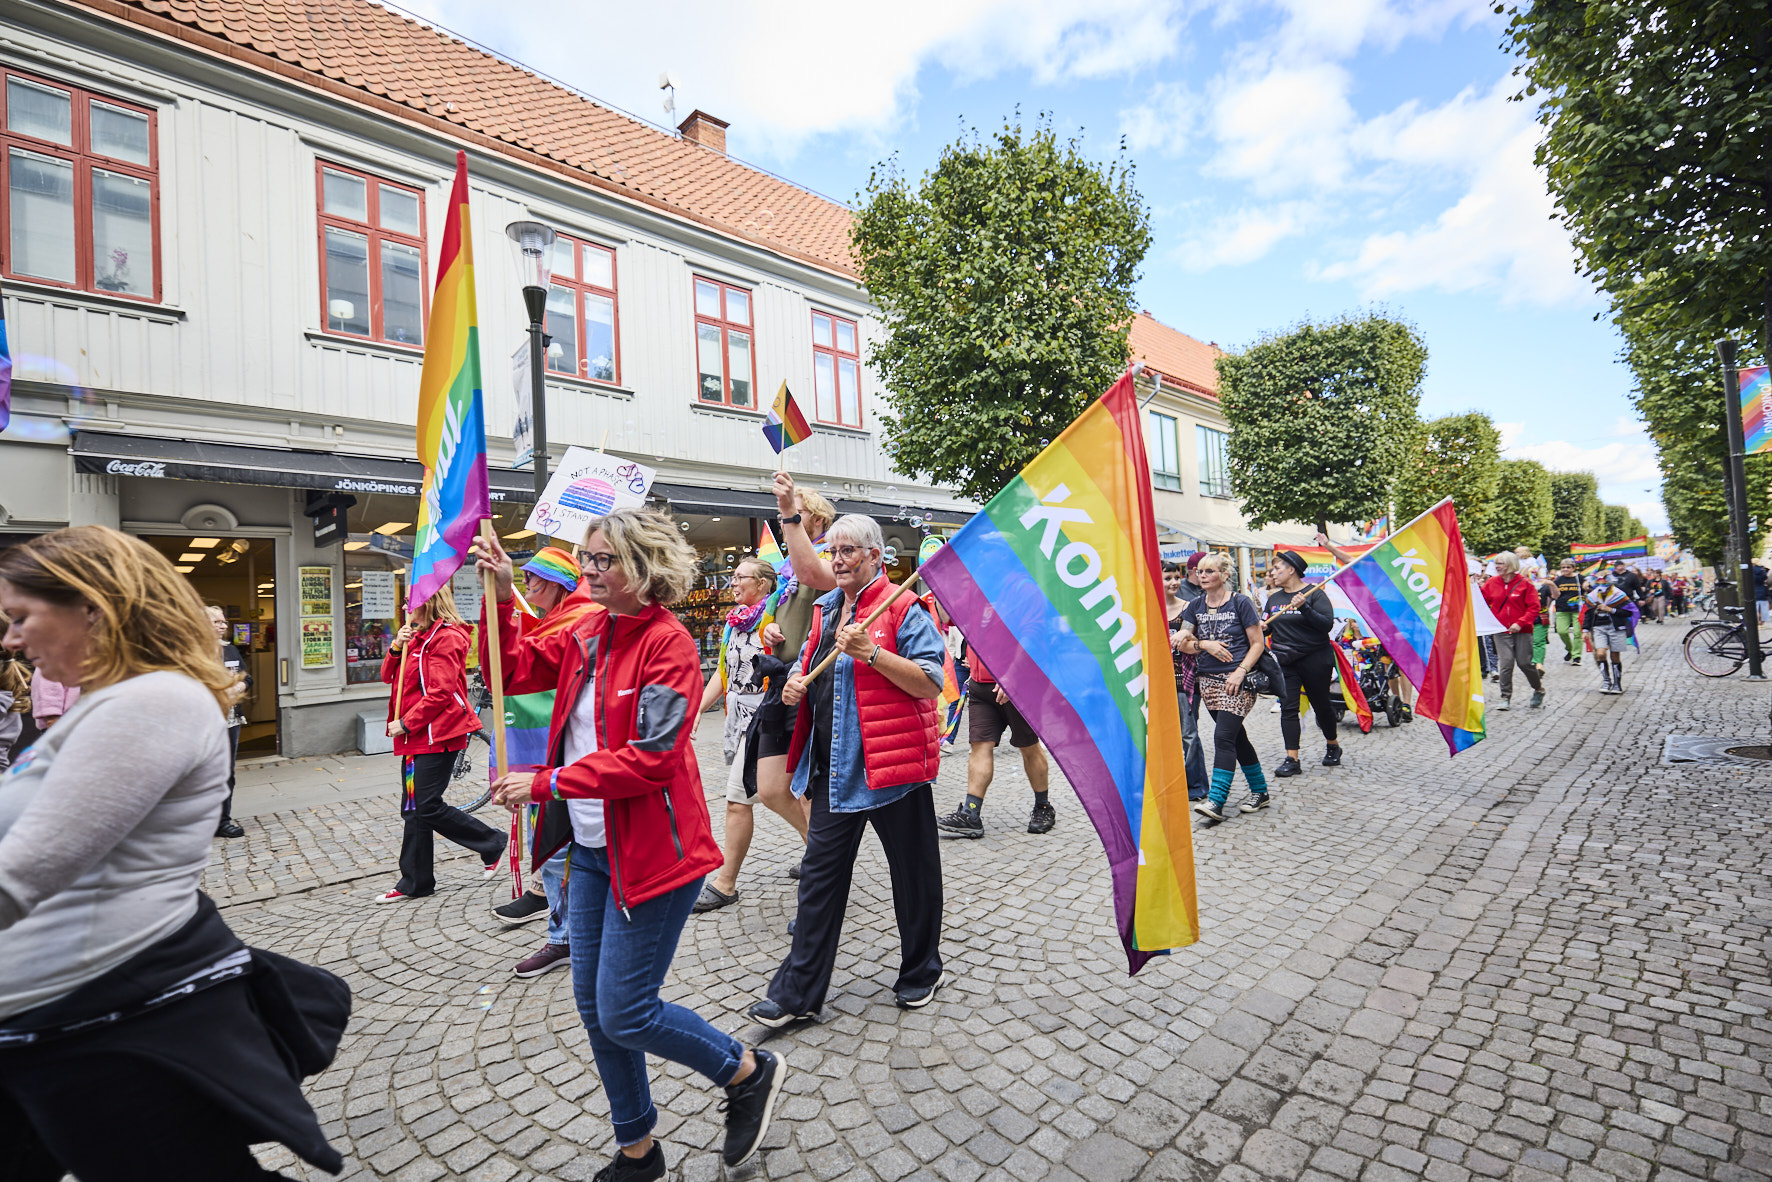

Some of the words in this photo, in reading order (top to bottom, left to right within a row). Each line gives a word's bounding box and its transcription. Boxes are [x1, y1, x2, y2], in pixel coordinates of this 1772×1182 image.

[106, 460, 166, 477] Coca-Cola
[571, 467, 590, 479] NOT
[592, 467, 598, 475] A
[599, 468, 623, 486] PHASE
[335, 479, 416, 495] JÖNKÖPINGS
[560, 509, 589, 522] STAND
[303, 623, 332, 632] GT
